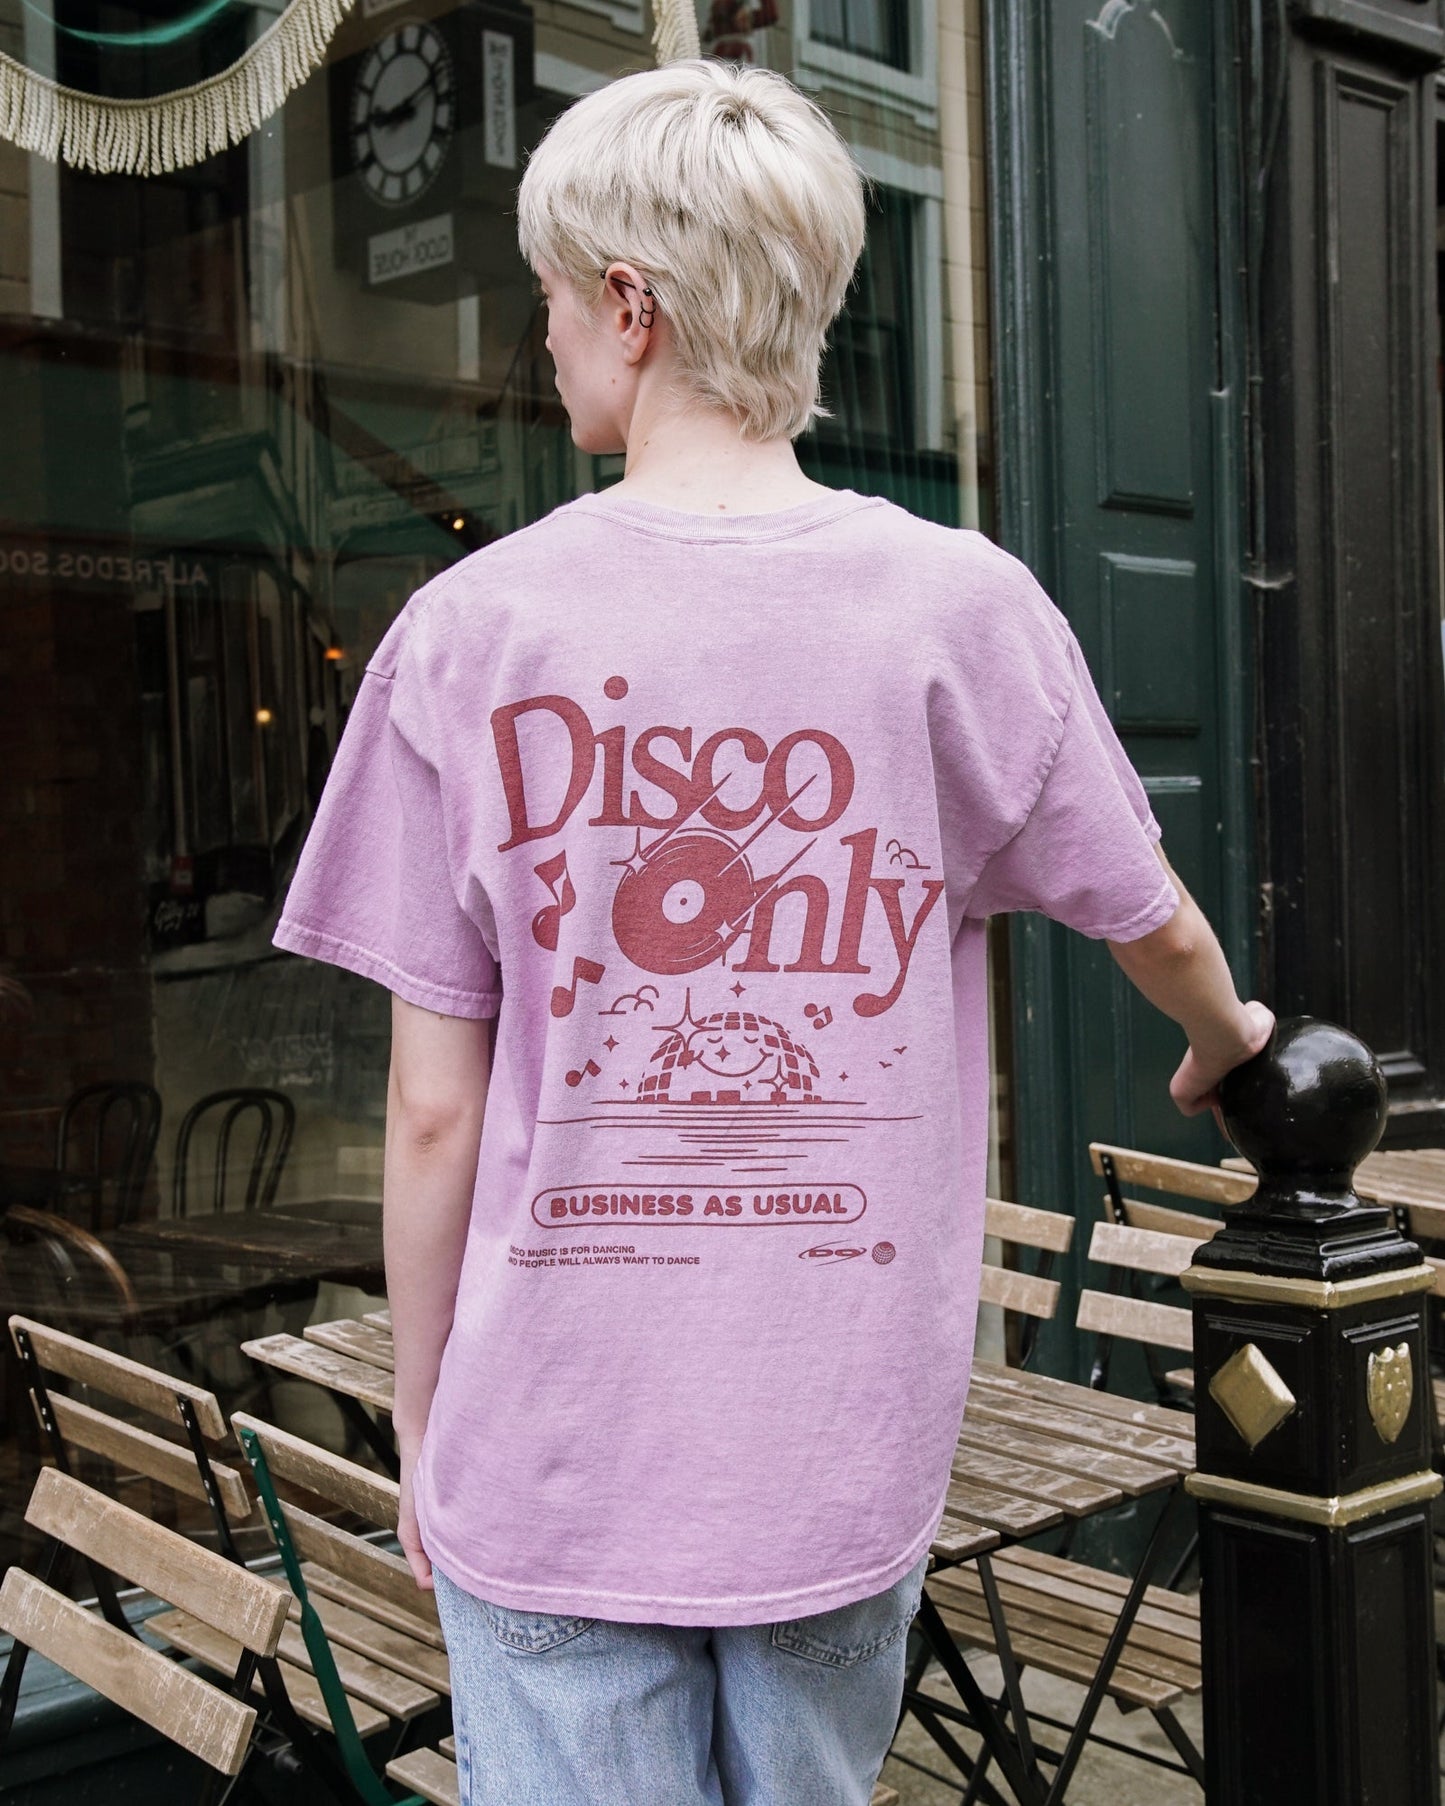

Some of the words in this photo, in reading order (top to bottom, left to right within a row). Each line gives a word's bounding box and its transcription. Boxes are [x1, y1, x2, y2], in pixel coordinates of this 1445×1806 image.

[490, 675, 855, 852] Disco
[550, 1194, 694, 1218] BUSINESS
[703, 1195, 743, 1216] AS
[753, 1193, 848, 1216] USUAL
[528, 1248, 557, 1258] MUSIC
[560, 1247, 568, 1255] IS
[571, 1246, 590, 1255] FOR
[593, 1245, 636, 1254] DANCING
[519, 1258, 556, 1269] PEOPLE
[558, 1257, 581, 1266] WILL
[583, 1256, 621, 1265] ALWAYS
[623, 1256, 650, 1265] WANT
[652, 1256, 665, 1265] TO
[667, 1256, 700, 1265] DANCE
